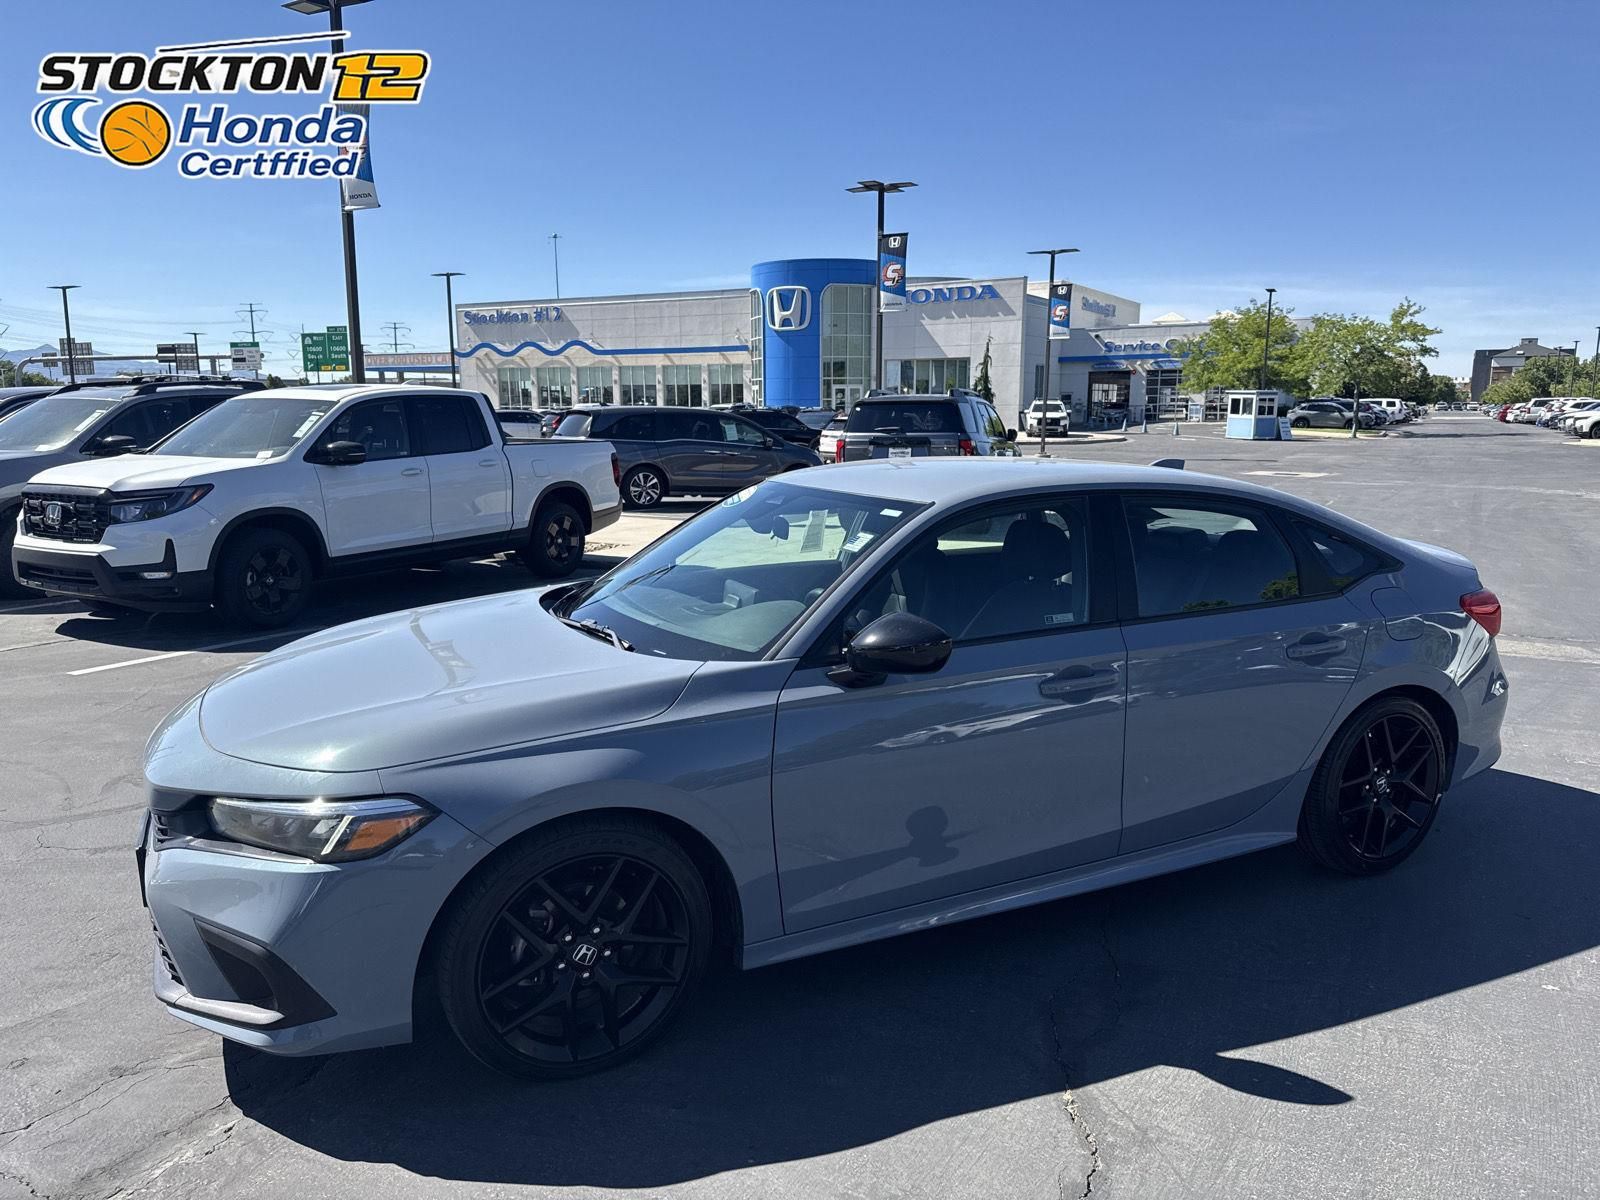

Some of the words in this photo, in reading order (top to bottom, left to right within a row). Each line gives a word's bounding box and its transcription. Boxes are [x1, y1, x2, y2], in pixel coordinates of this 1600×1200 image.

[349, 192, 373, 200] HONDA
[464, 310, 528, 324] Stockton
[1104, 340, 1160, 353] Service
